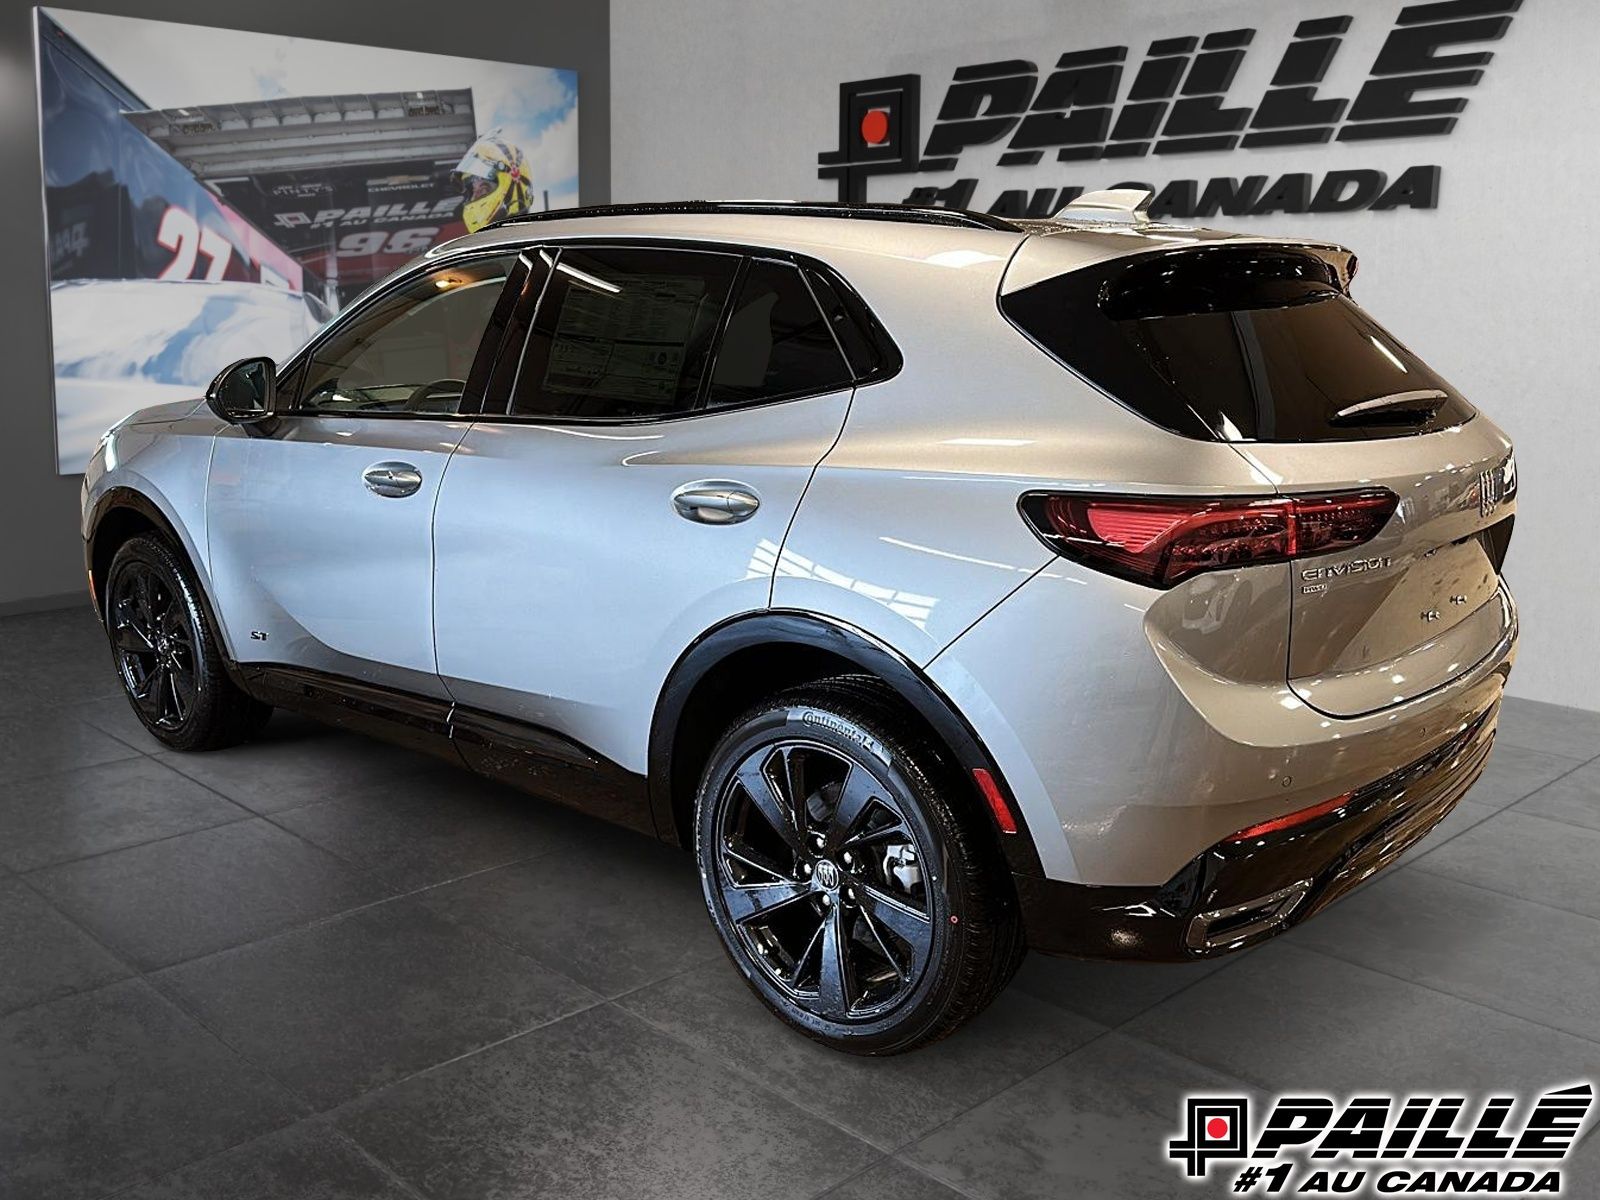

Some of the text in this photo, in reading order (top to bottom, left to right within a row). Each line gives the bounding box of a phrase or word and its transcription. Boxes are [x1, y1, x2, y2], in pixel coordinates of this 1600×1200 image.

[367, 182, 436, 193] CHEVROLET
[985, 187, 1085, 219] AU
[310, 212, 454, 229] #1 AU CANADA
[158, 205, 233, 281] 27
[337, 227, 440, 258] 96
[1301, 555, 1391, 581] ENVISION
[250, 631, 268, 641] ST
